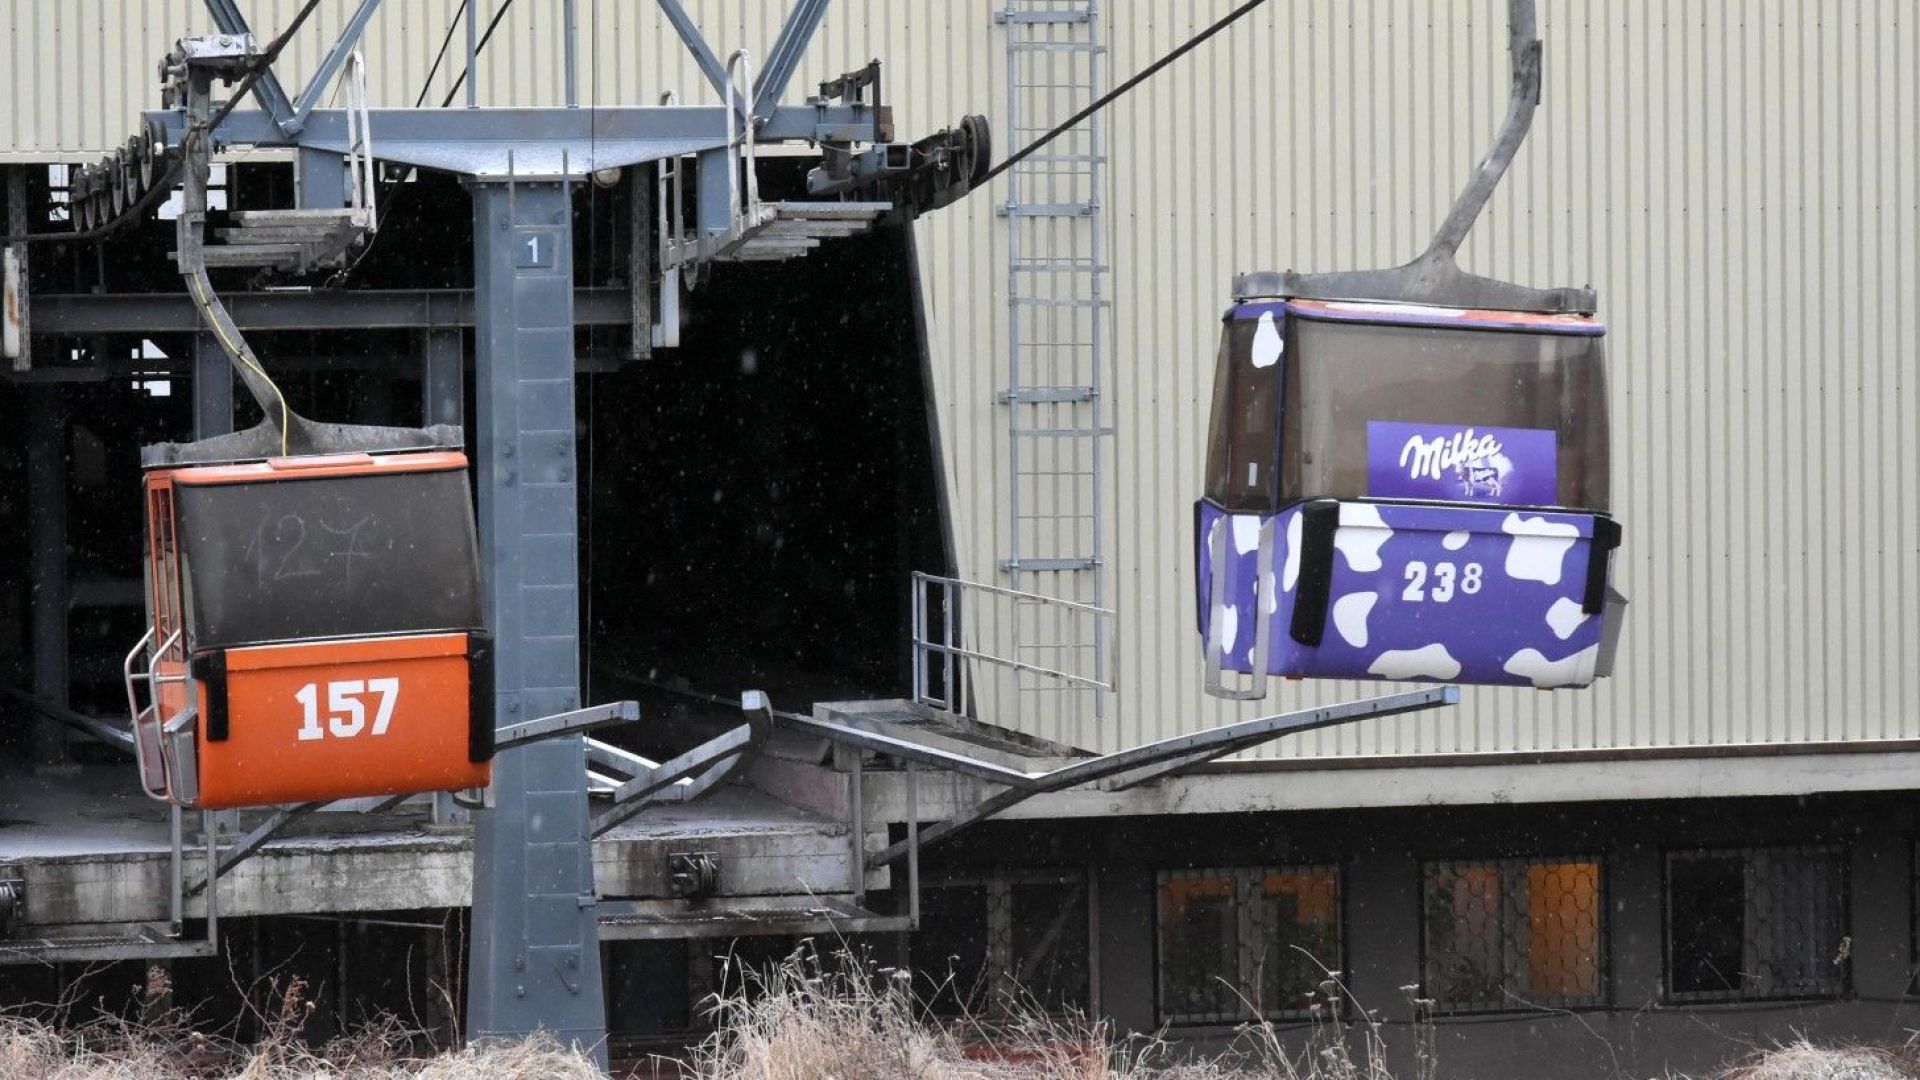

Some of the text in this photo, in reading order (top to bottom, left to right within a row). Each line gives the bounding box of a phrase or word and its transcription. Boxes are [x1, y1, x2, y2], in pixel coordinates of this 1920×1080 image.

[527, 236, 539, 264] 1
[1400, 428, 1503, 480] Milka
[1402, 561, 1483, 602] 238
[294, 677, 400, 741] 157
